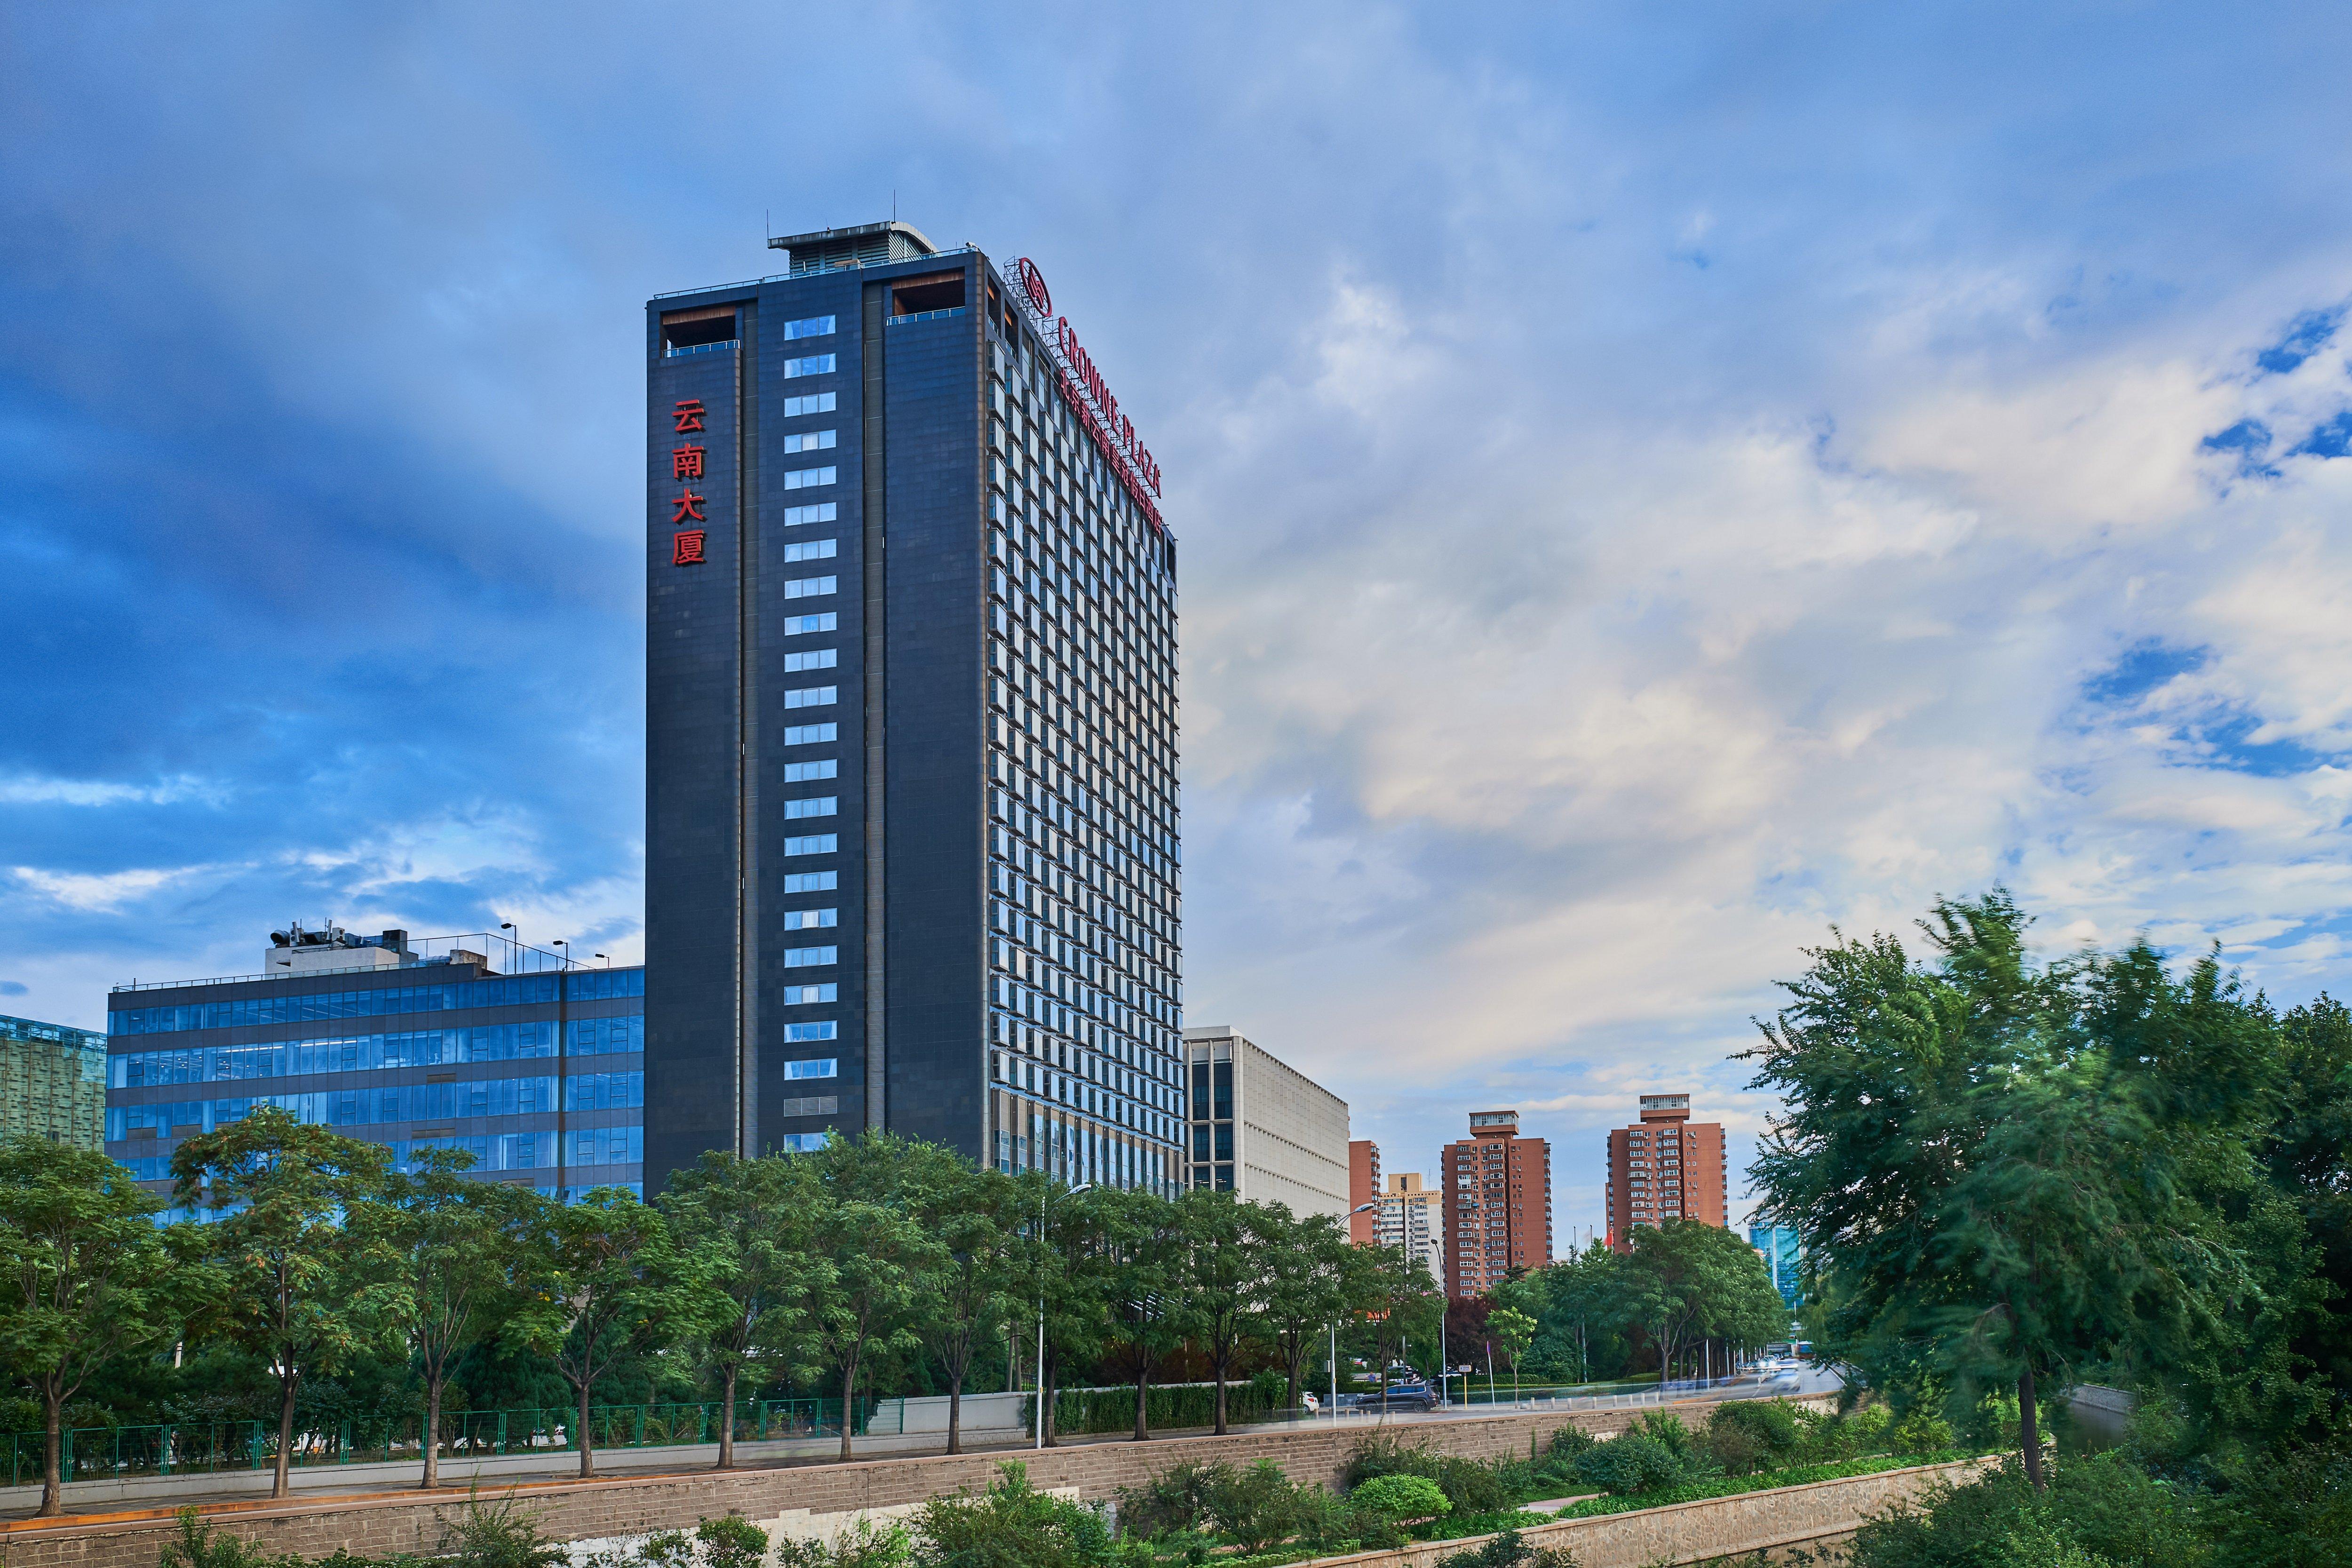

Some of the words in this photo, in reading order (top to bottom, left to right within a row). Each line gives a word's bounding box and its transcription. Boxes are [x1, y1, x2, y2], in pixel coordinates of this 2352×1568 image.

[672, 399, 705, 565] 云南大厦
[1058, 316, 1119, 435] CROWNE
[1123, 414, 1161, 499] PLAZA
[1061, 367, 1161, 536] 北京新云南皇冠假日酒店
